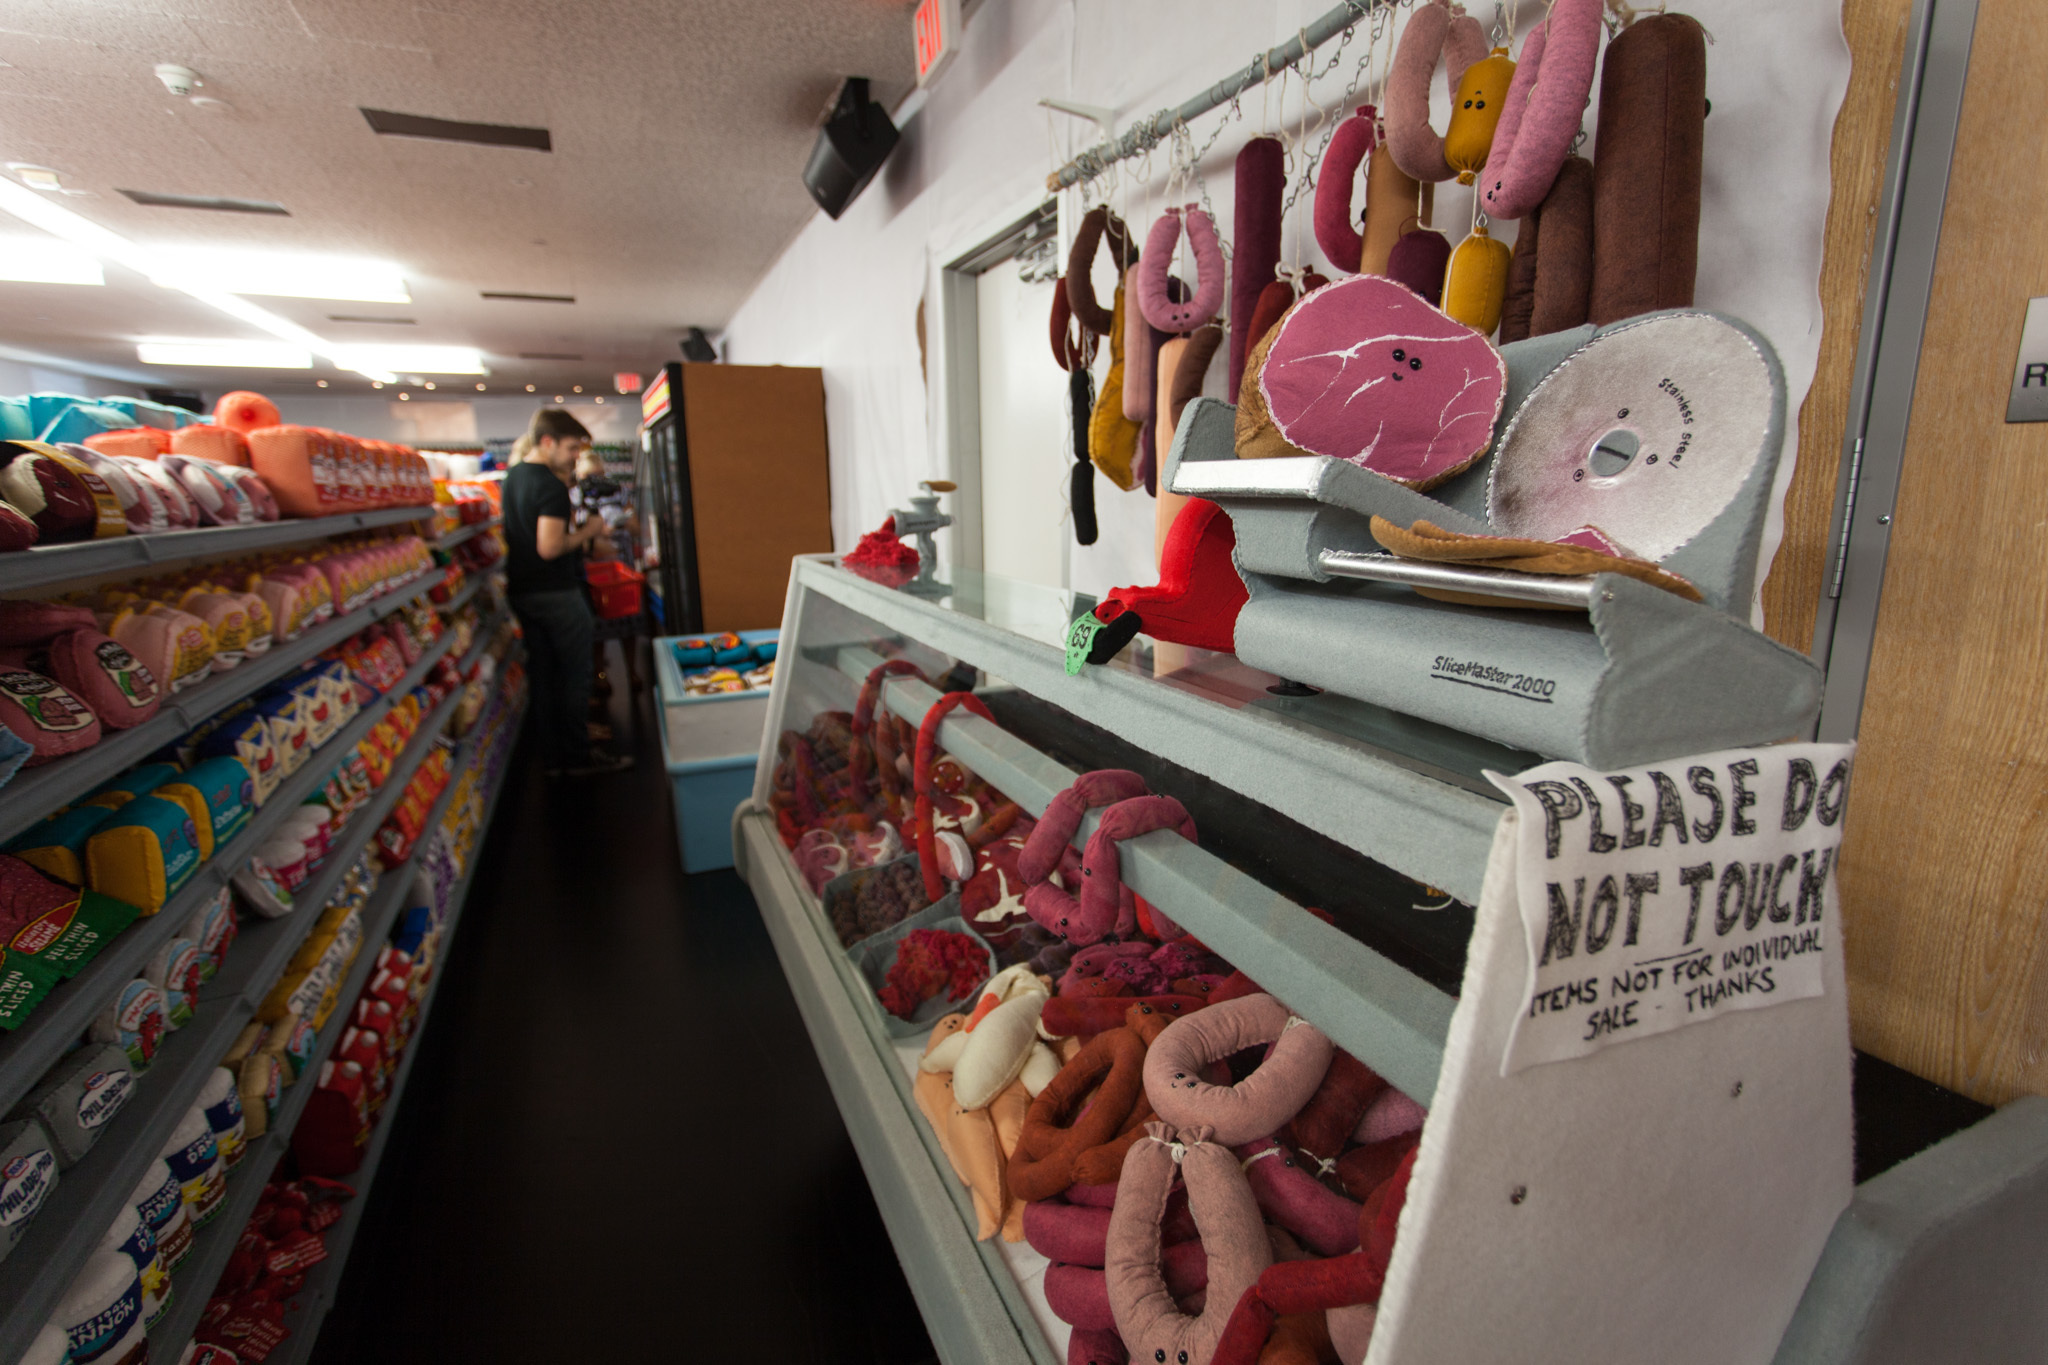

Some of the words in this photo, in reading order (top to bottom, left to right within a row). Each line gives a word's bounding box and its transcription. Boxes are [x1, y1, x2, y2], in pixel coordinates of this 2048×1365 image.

[1658, 378, 1694, 425] Stainless
[1668, 432, 1692, 469] Steel
[1524, 758, 1760, 859] PLEASE
[1781, 758, 1849, 832] DO
[1538, 871, 1659, 967] NOT
[1679, 847, 1833, 946] TOUCH
[44, 944, 69, 961] DELI
[61, 921, 90, 944] THIN
[63, 931, 100, 961] SLICED
[1529, 977, 1599, 1018] ITEMS
[1611, 967, 1664, 999] NOT
[1673, 954, 1713, 983] FOR
[1722, 928, 1823, 970] INDIVIDUAL
[0, 980, 35, 1018] SLICED
[1583, 1001, 1640, 1041] SALE
[1685, 966, 1776, 1013] THANKS
[69, 1297, 136, 1350] ANNON
